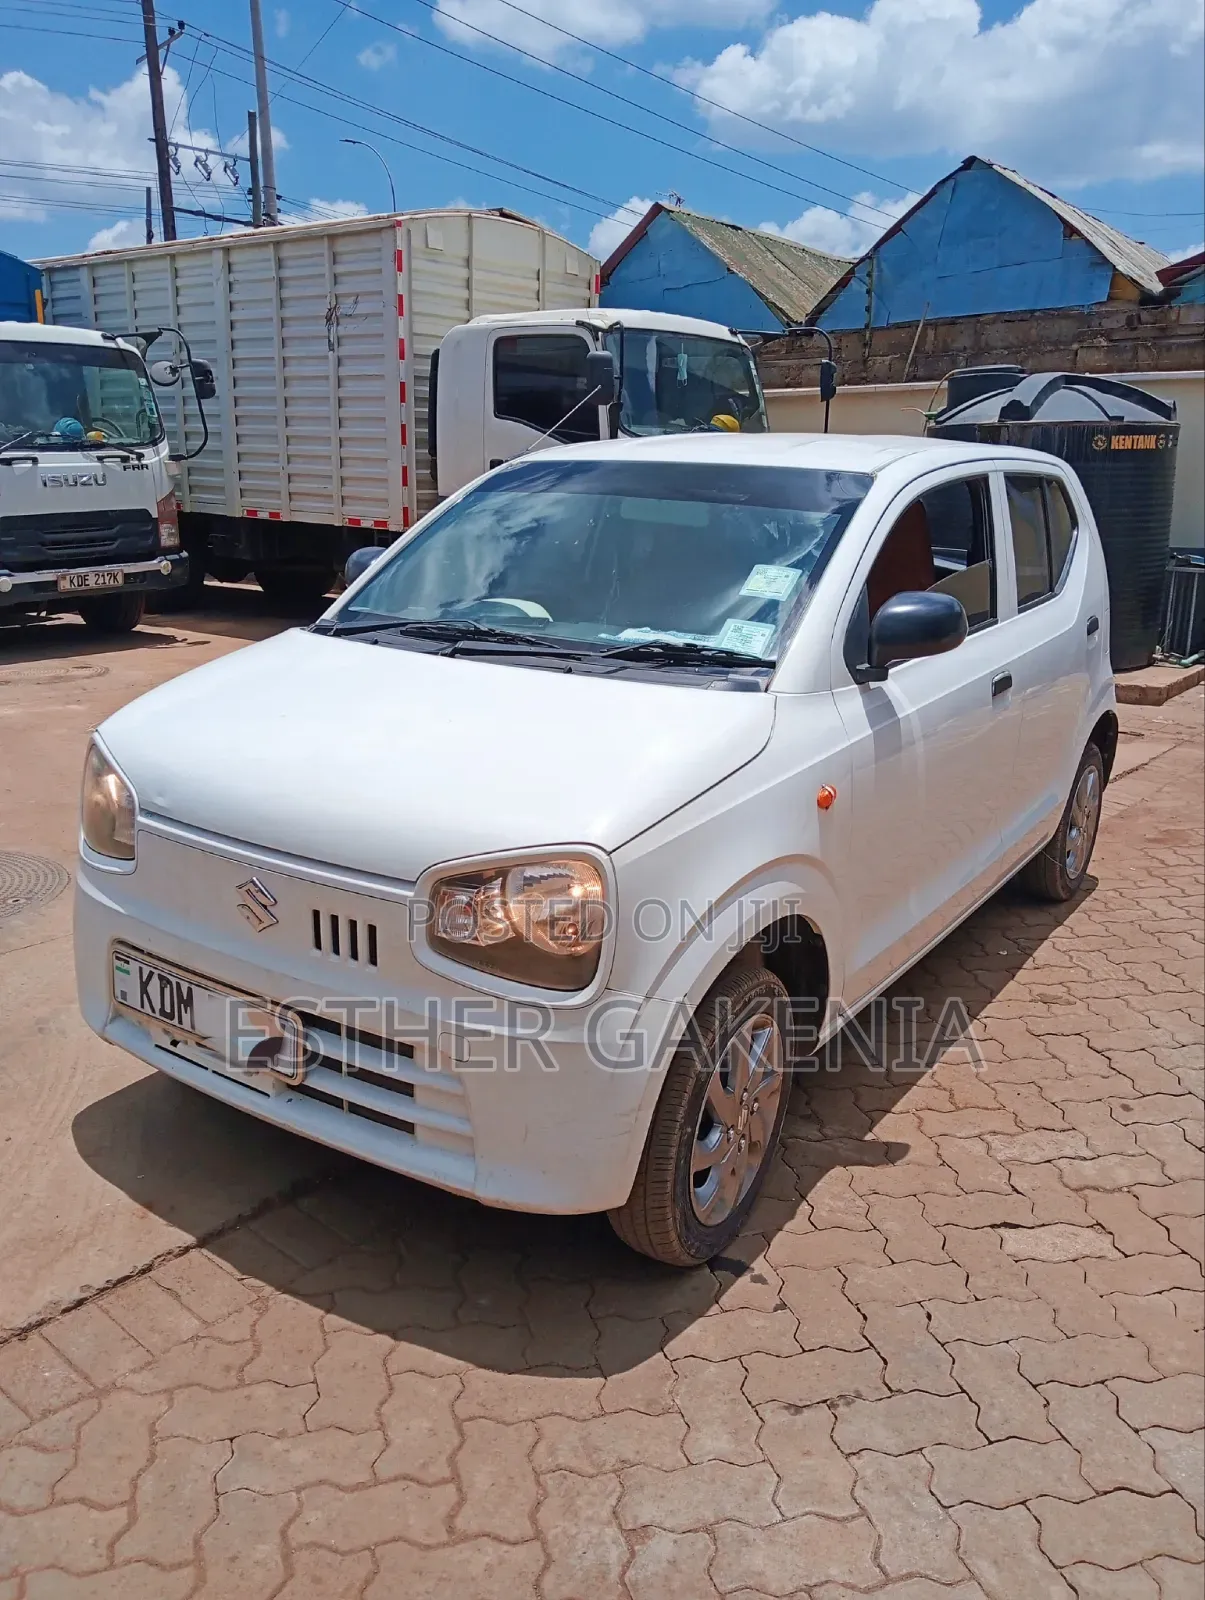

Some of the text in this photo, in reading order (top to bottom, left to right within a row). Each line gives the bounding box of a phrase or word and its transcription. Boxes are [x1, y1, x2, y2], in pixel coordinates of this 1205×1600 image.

[1110, 434, 1157, 450] KENTANK
[122, 463, 150, 472] FRR
[40, 472, 107, 488] ISUZU
[69, 571, 120, 588] KDE 217K
[138, 965, 196, 1031] KDM
